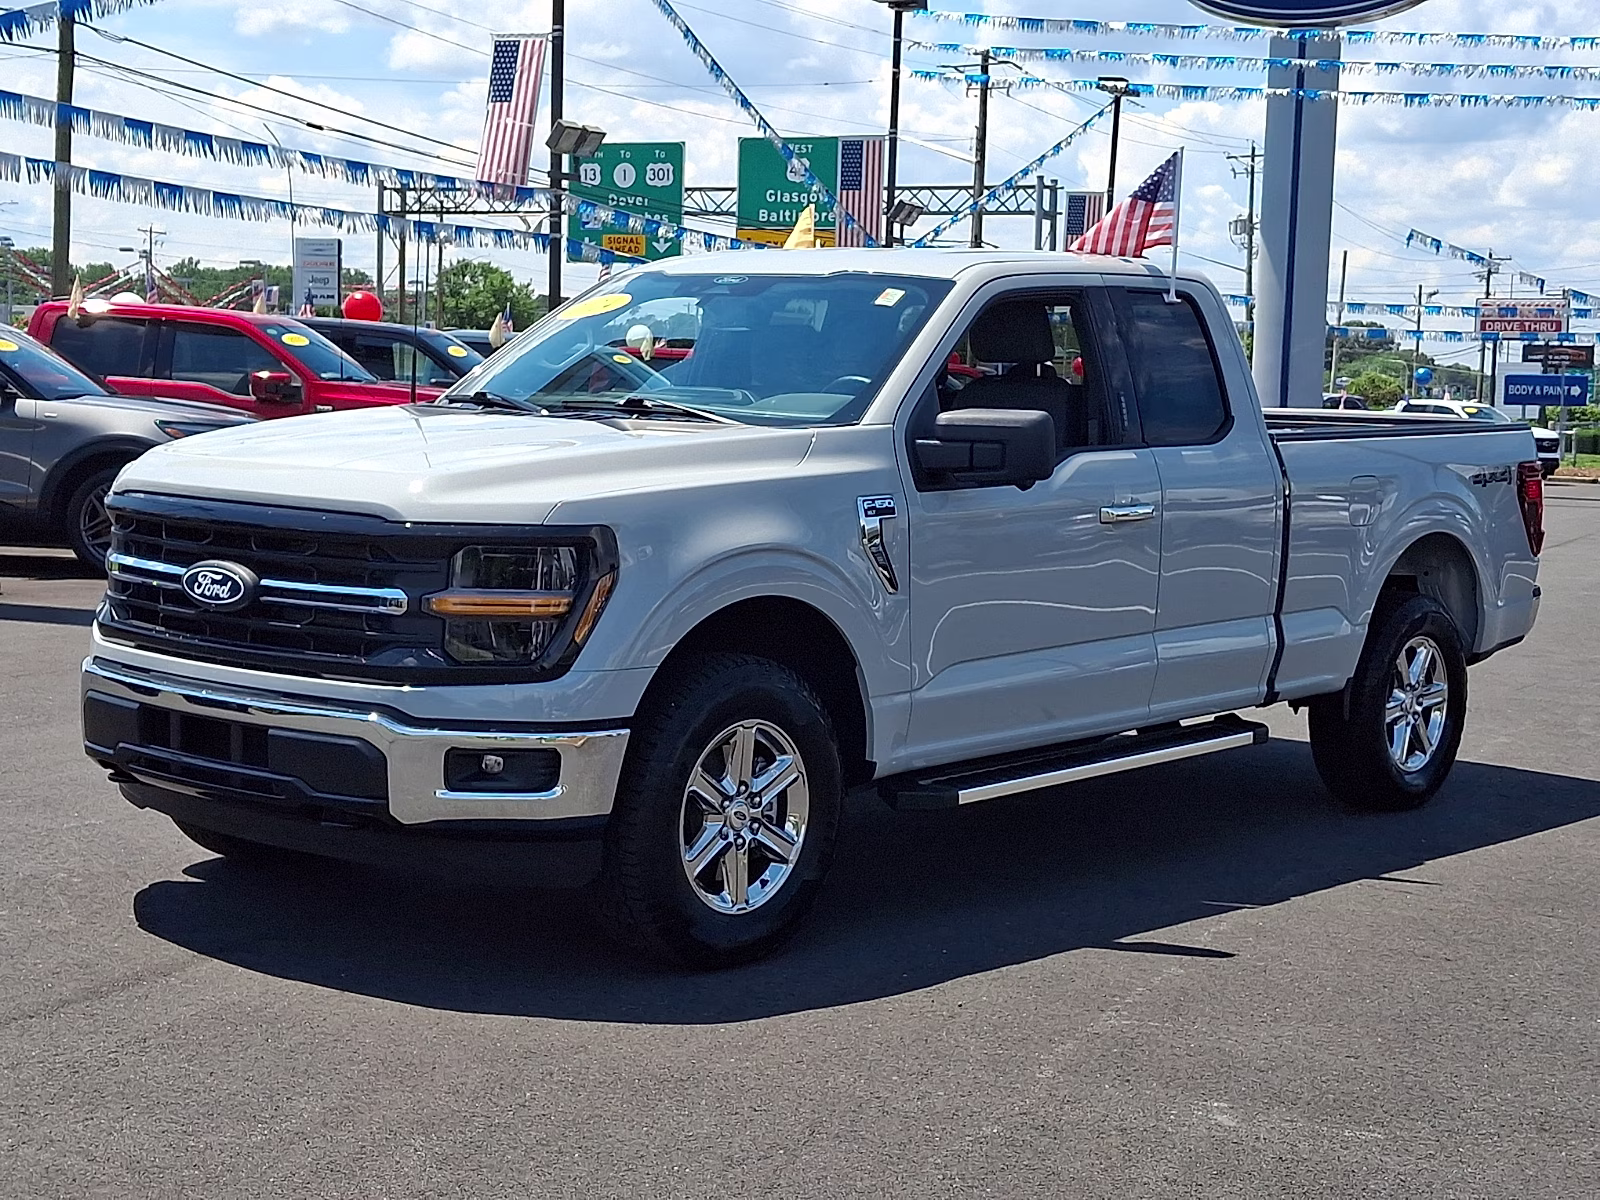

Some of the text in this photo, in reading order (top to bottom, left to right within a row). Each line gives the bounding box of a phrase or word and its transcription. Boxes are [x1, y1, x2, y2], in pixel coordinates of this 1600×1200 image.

[584, 168, 597, 181] 13
[622, 168, 627, 181] 1
[648, 168, 670, 181] 301
[608, 194, 649, 206] Dover
[766, 190, 823, 207] Glasgo
[758, 209, 836, 222] Baltiore
[607, 237, 641, 245] SIGNAL
[308, 275, 330, 286] Jeep
[1485, 321, 1557, 332] DRIVE THRU
[1508, 385, 1569, 395] BODY & PAINT
[863, 499, 894, 509] F-150
[193, 571, 233, 599] Ford
